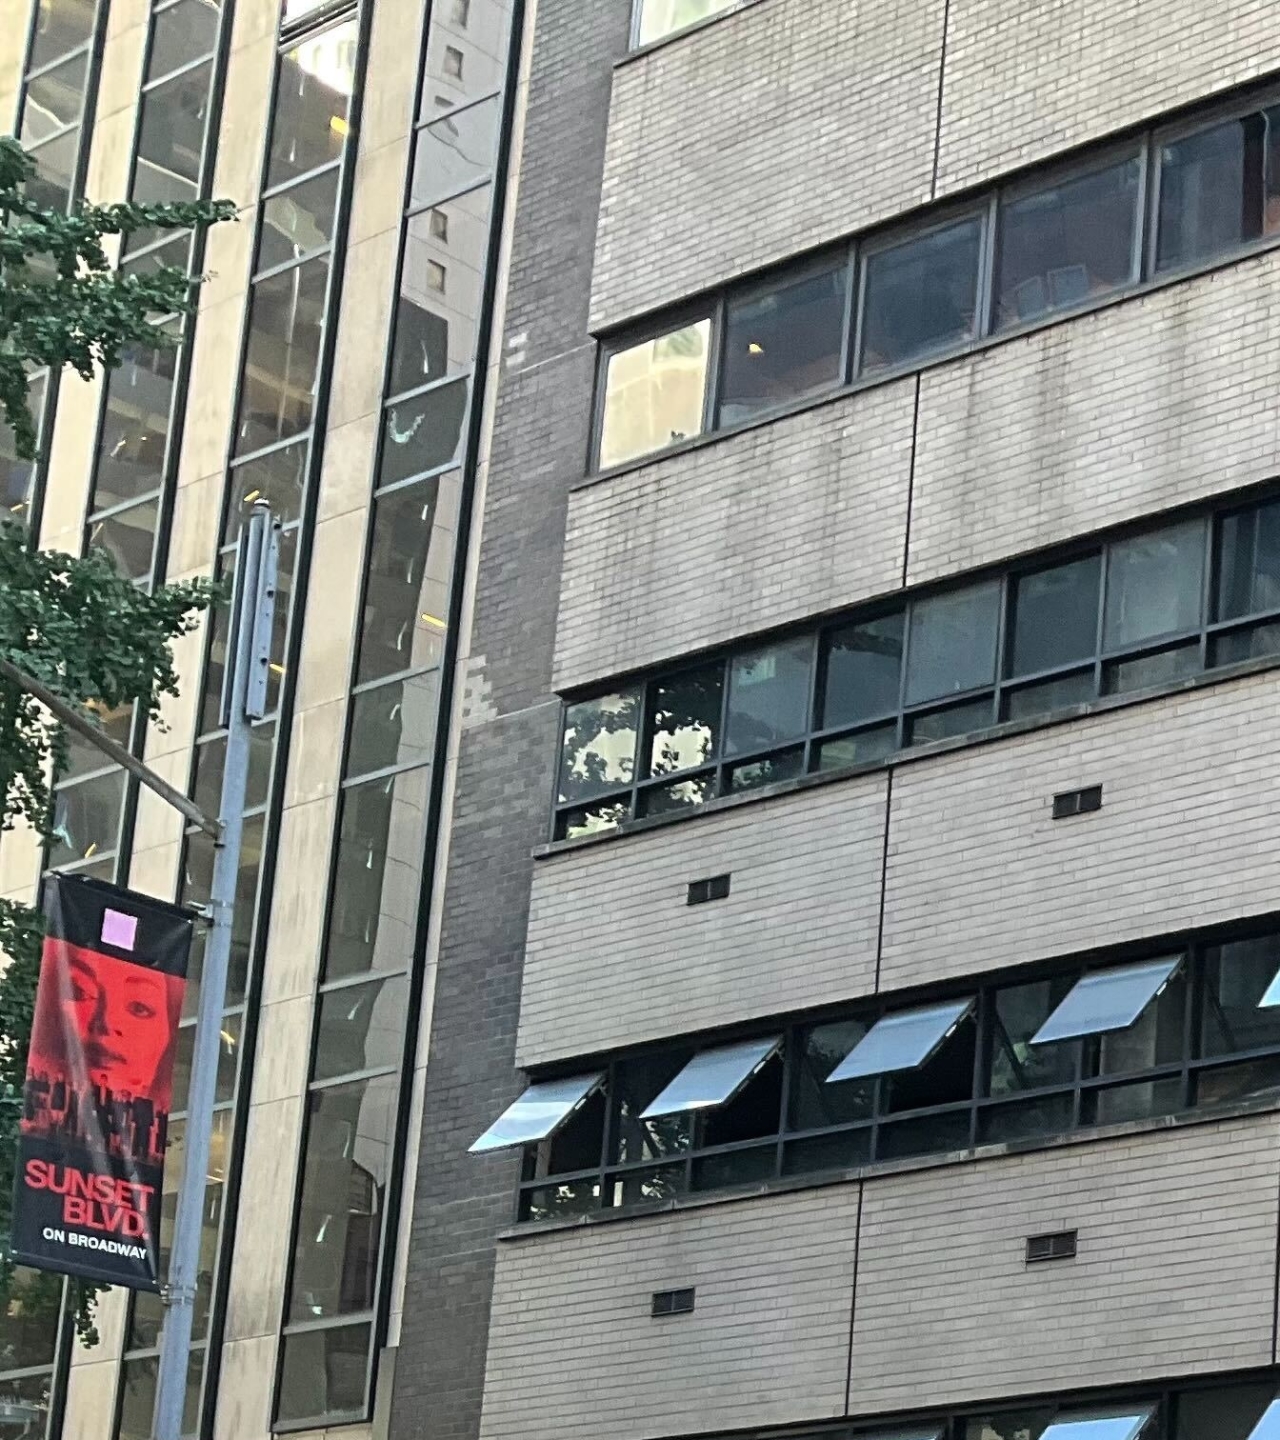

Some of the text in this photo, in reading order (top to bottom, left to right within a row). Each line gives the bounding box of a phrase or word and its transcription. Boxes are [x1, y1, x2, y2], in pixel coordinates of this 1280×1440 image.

[24, 1158, 154, 1211] SUNSET
[63, 1196, 149, 1240] BLVD.
[43, 1227, 147, 1260] ON BROADWAY
